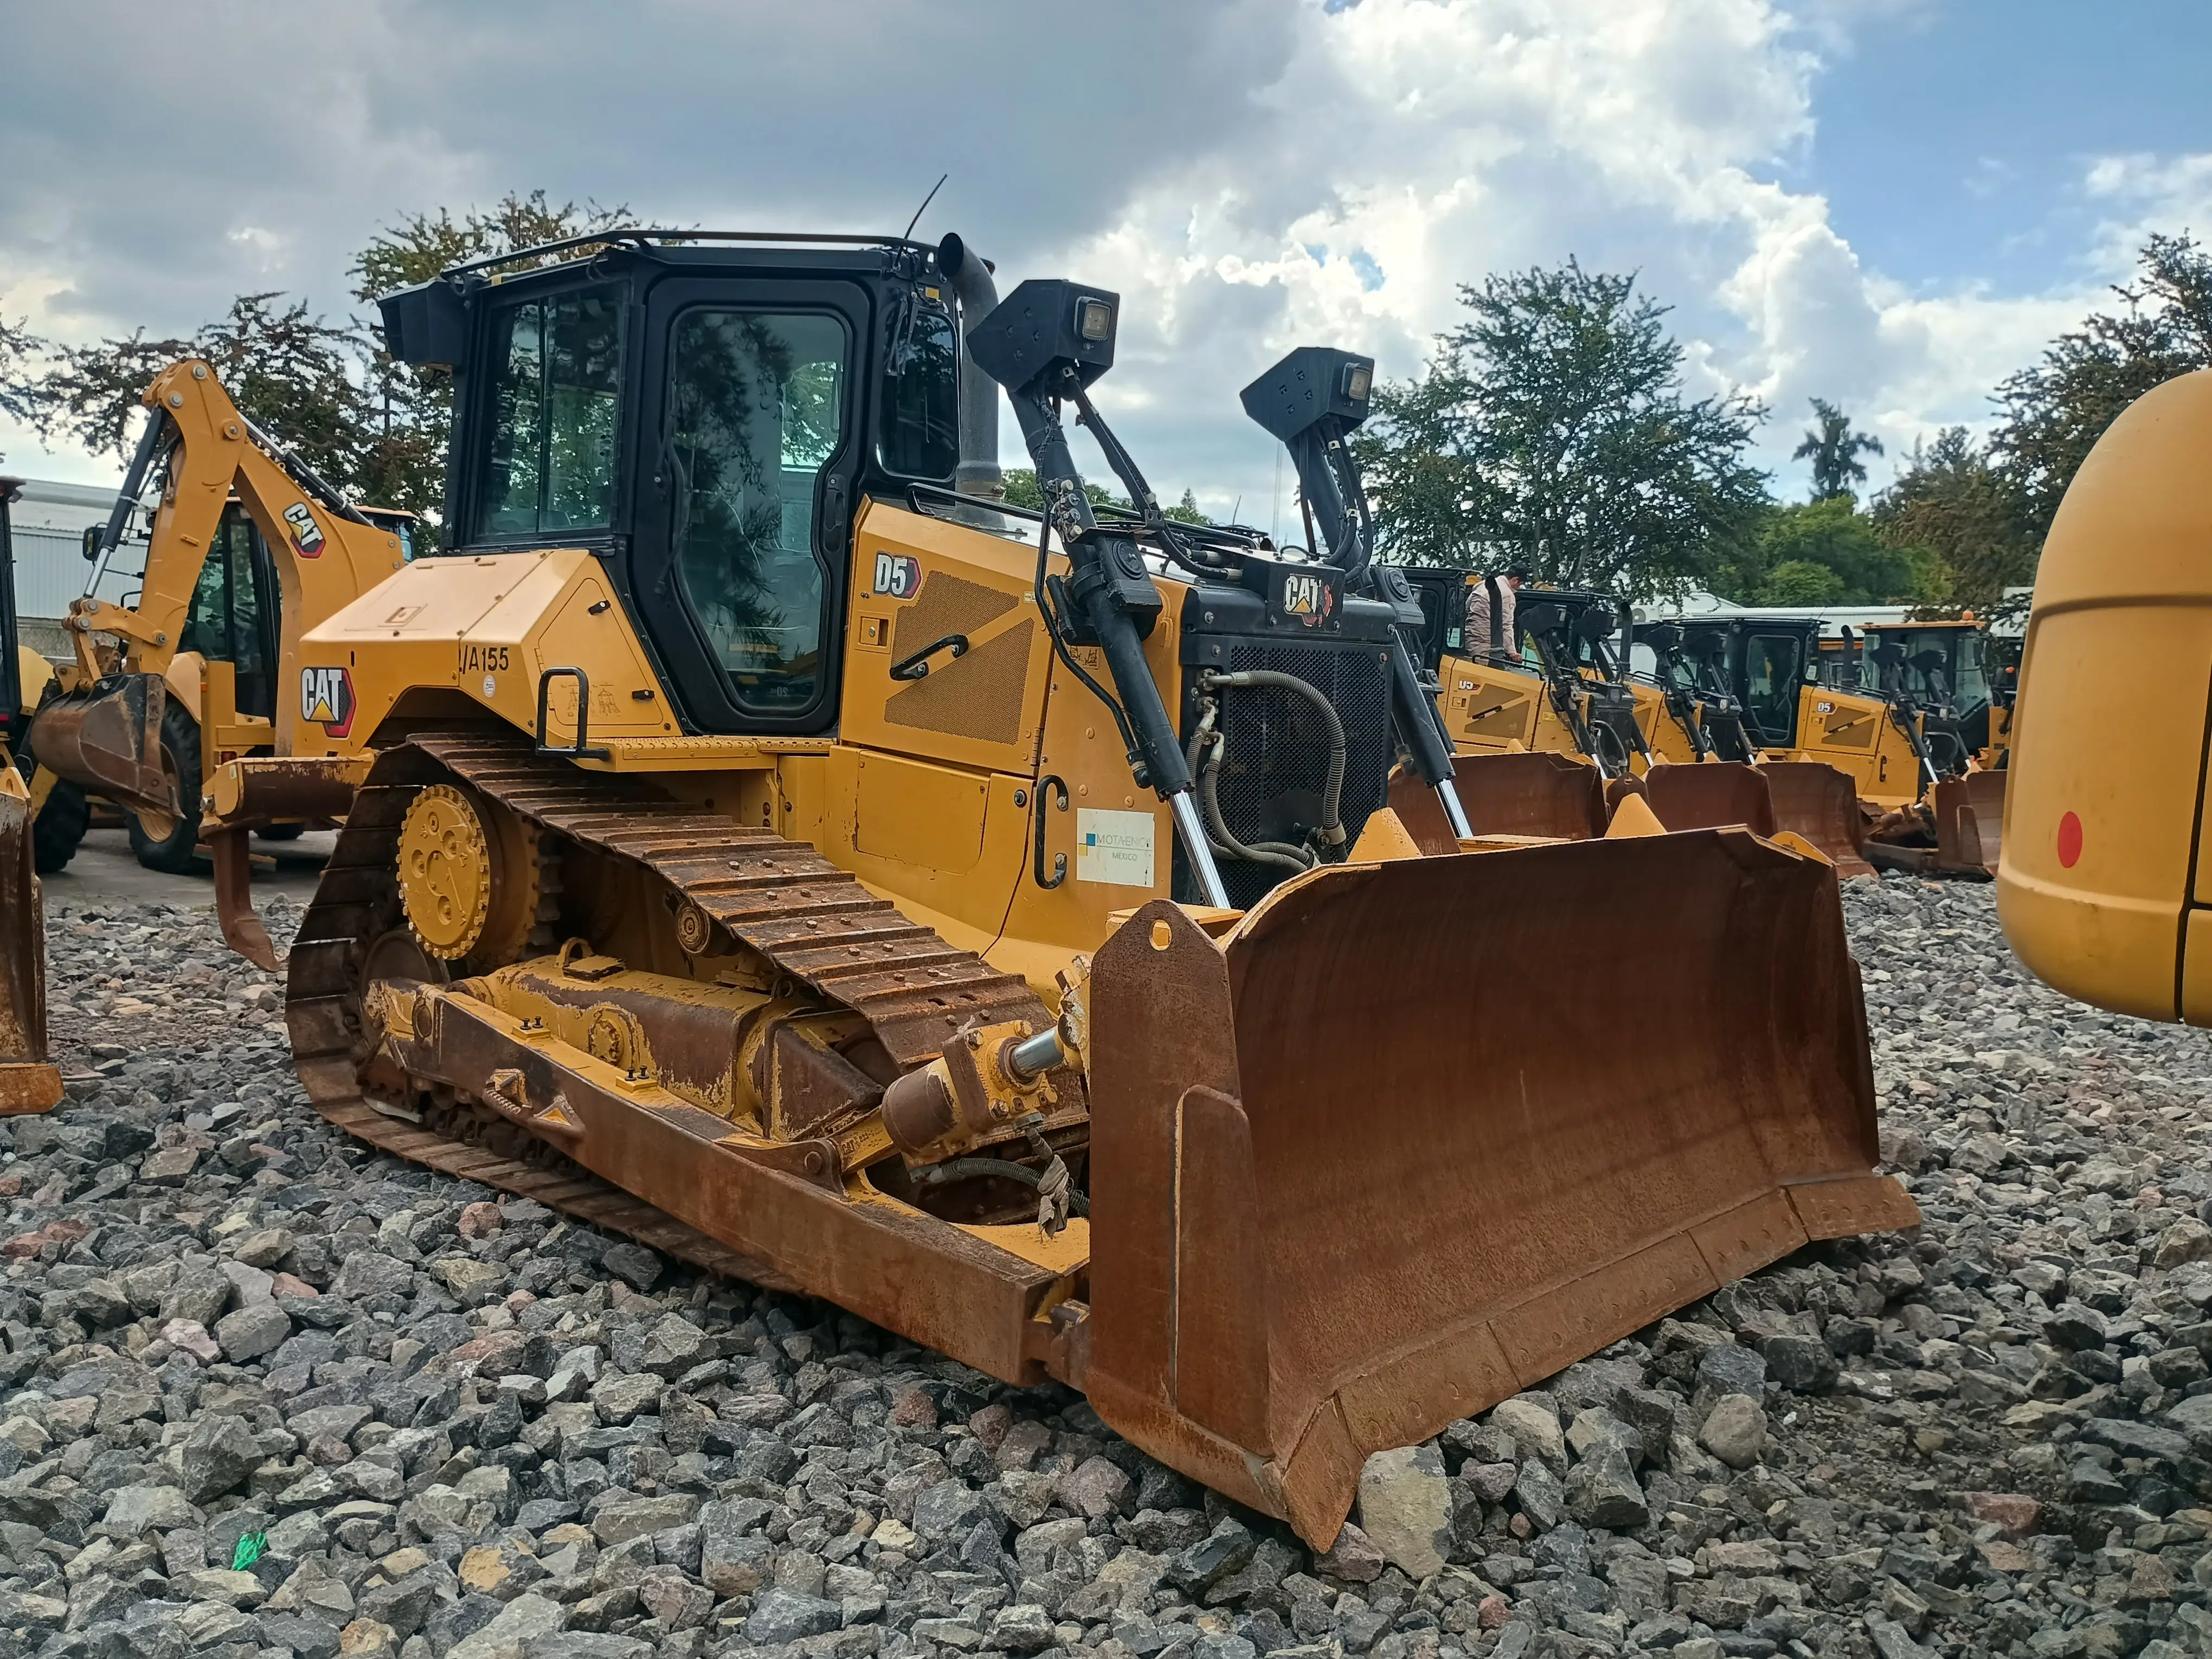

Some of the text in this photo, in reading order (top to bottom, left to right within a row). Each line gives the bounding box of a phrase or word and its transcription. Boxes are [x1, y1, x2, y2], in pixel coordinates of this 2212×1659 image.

[284, 503, 324, 546] CAT
[874, 554, 908, 595] D5
[1285, 576, 1321, 613] CAT
[301, 668, 342, 721] CAT
[1818, 702, 1831, 712] D5
[1112, 851, 1137, 861] MÉXICO
